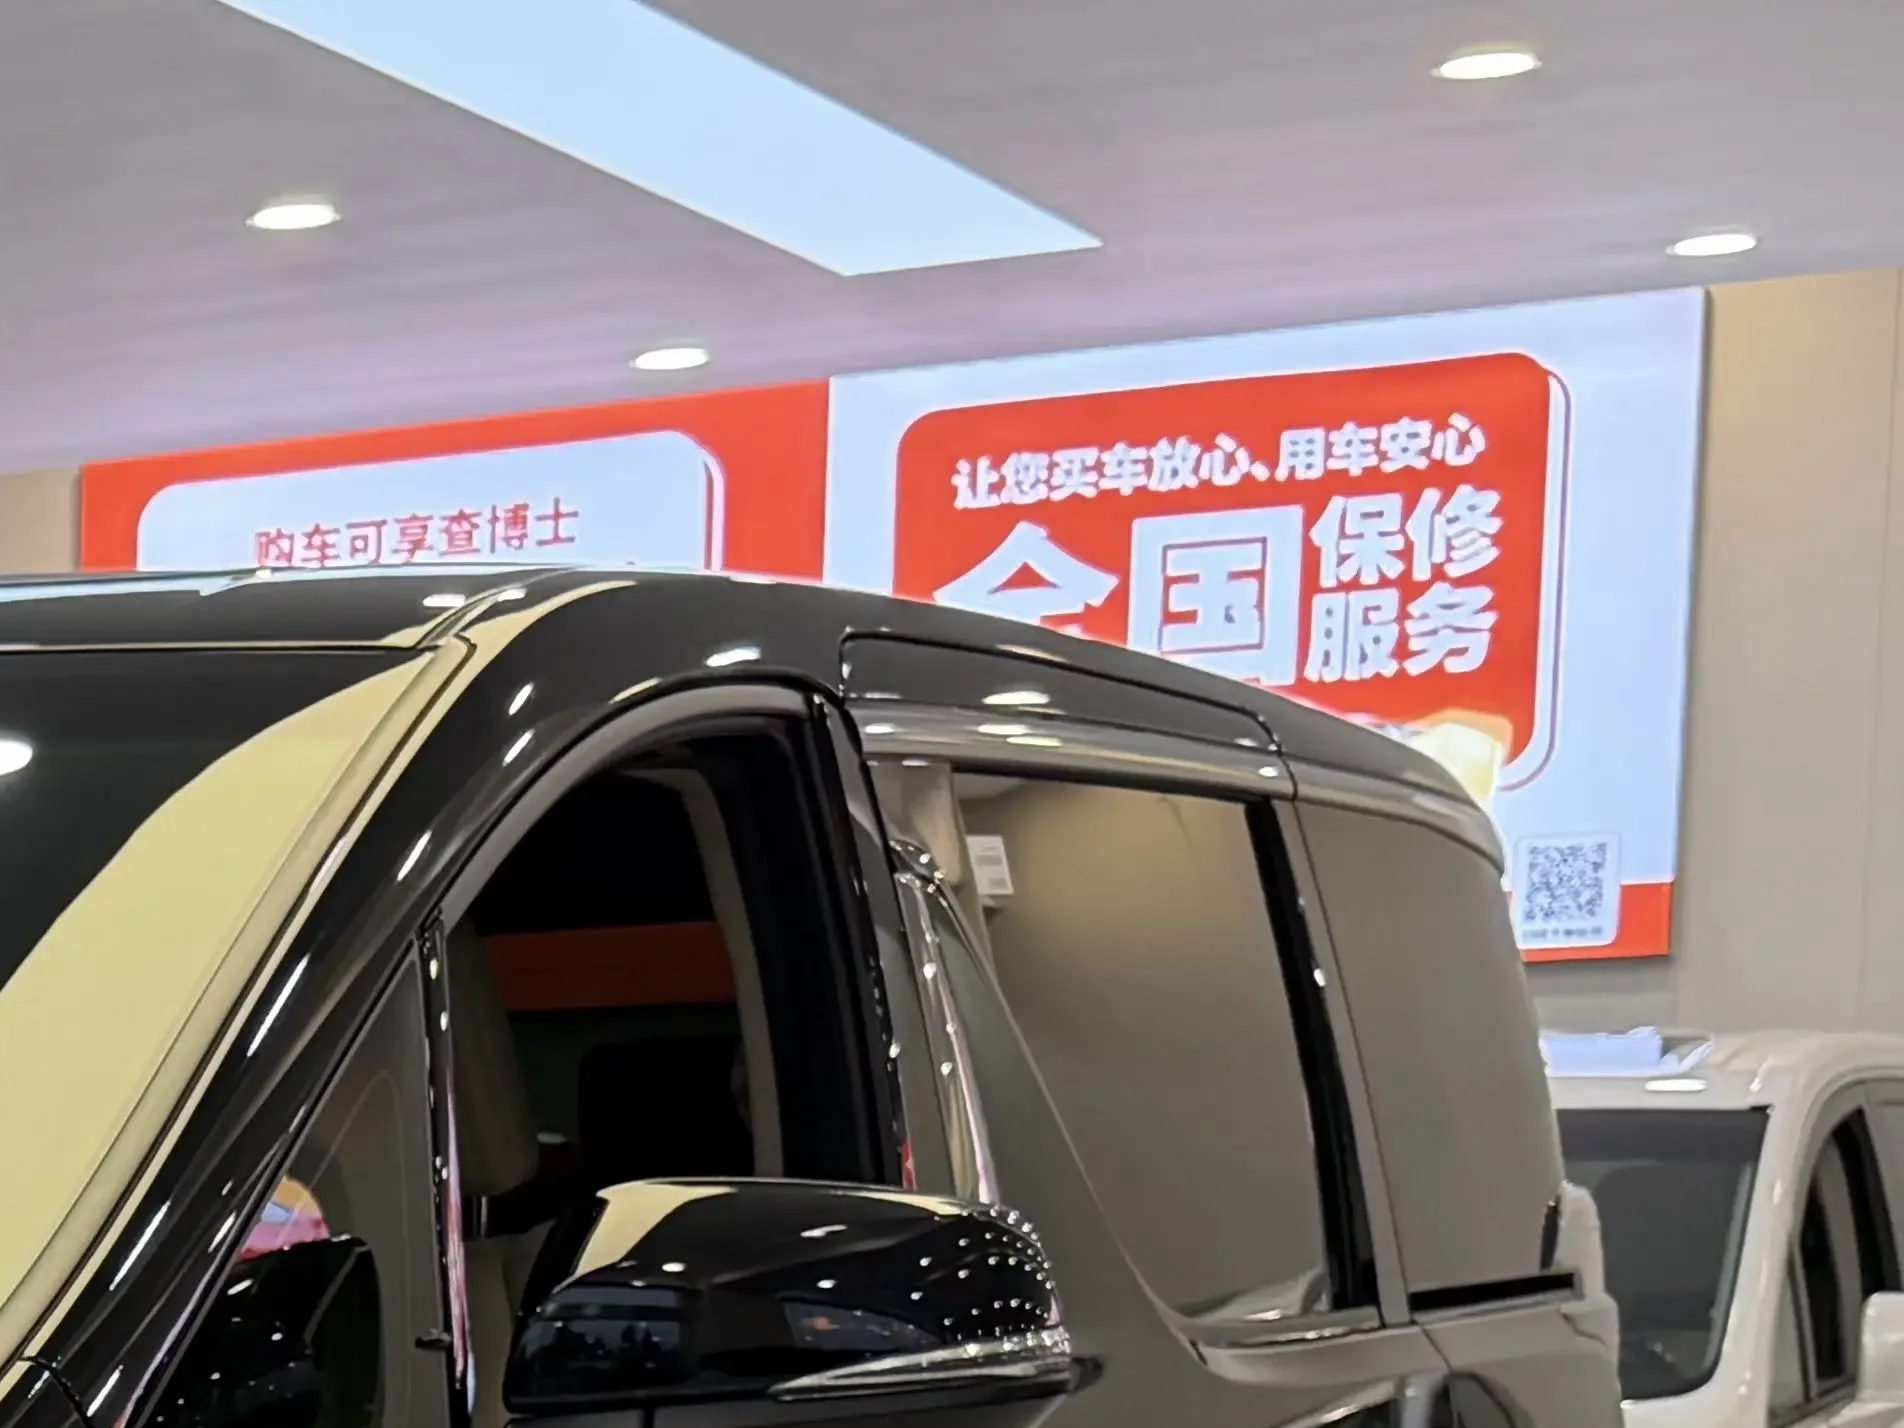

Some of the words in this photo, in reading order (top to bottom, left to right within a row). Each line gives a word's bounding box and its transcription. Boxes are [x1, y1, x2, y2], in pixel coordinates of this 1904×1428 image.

[950, 412, 1486, 510] 让您买车放心、用车安心
[254, 497, 580, 568] 购车可享查博士
[1310, 485, 1502, 588] 保修
[1303, 583, 1498, 682] 服务
